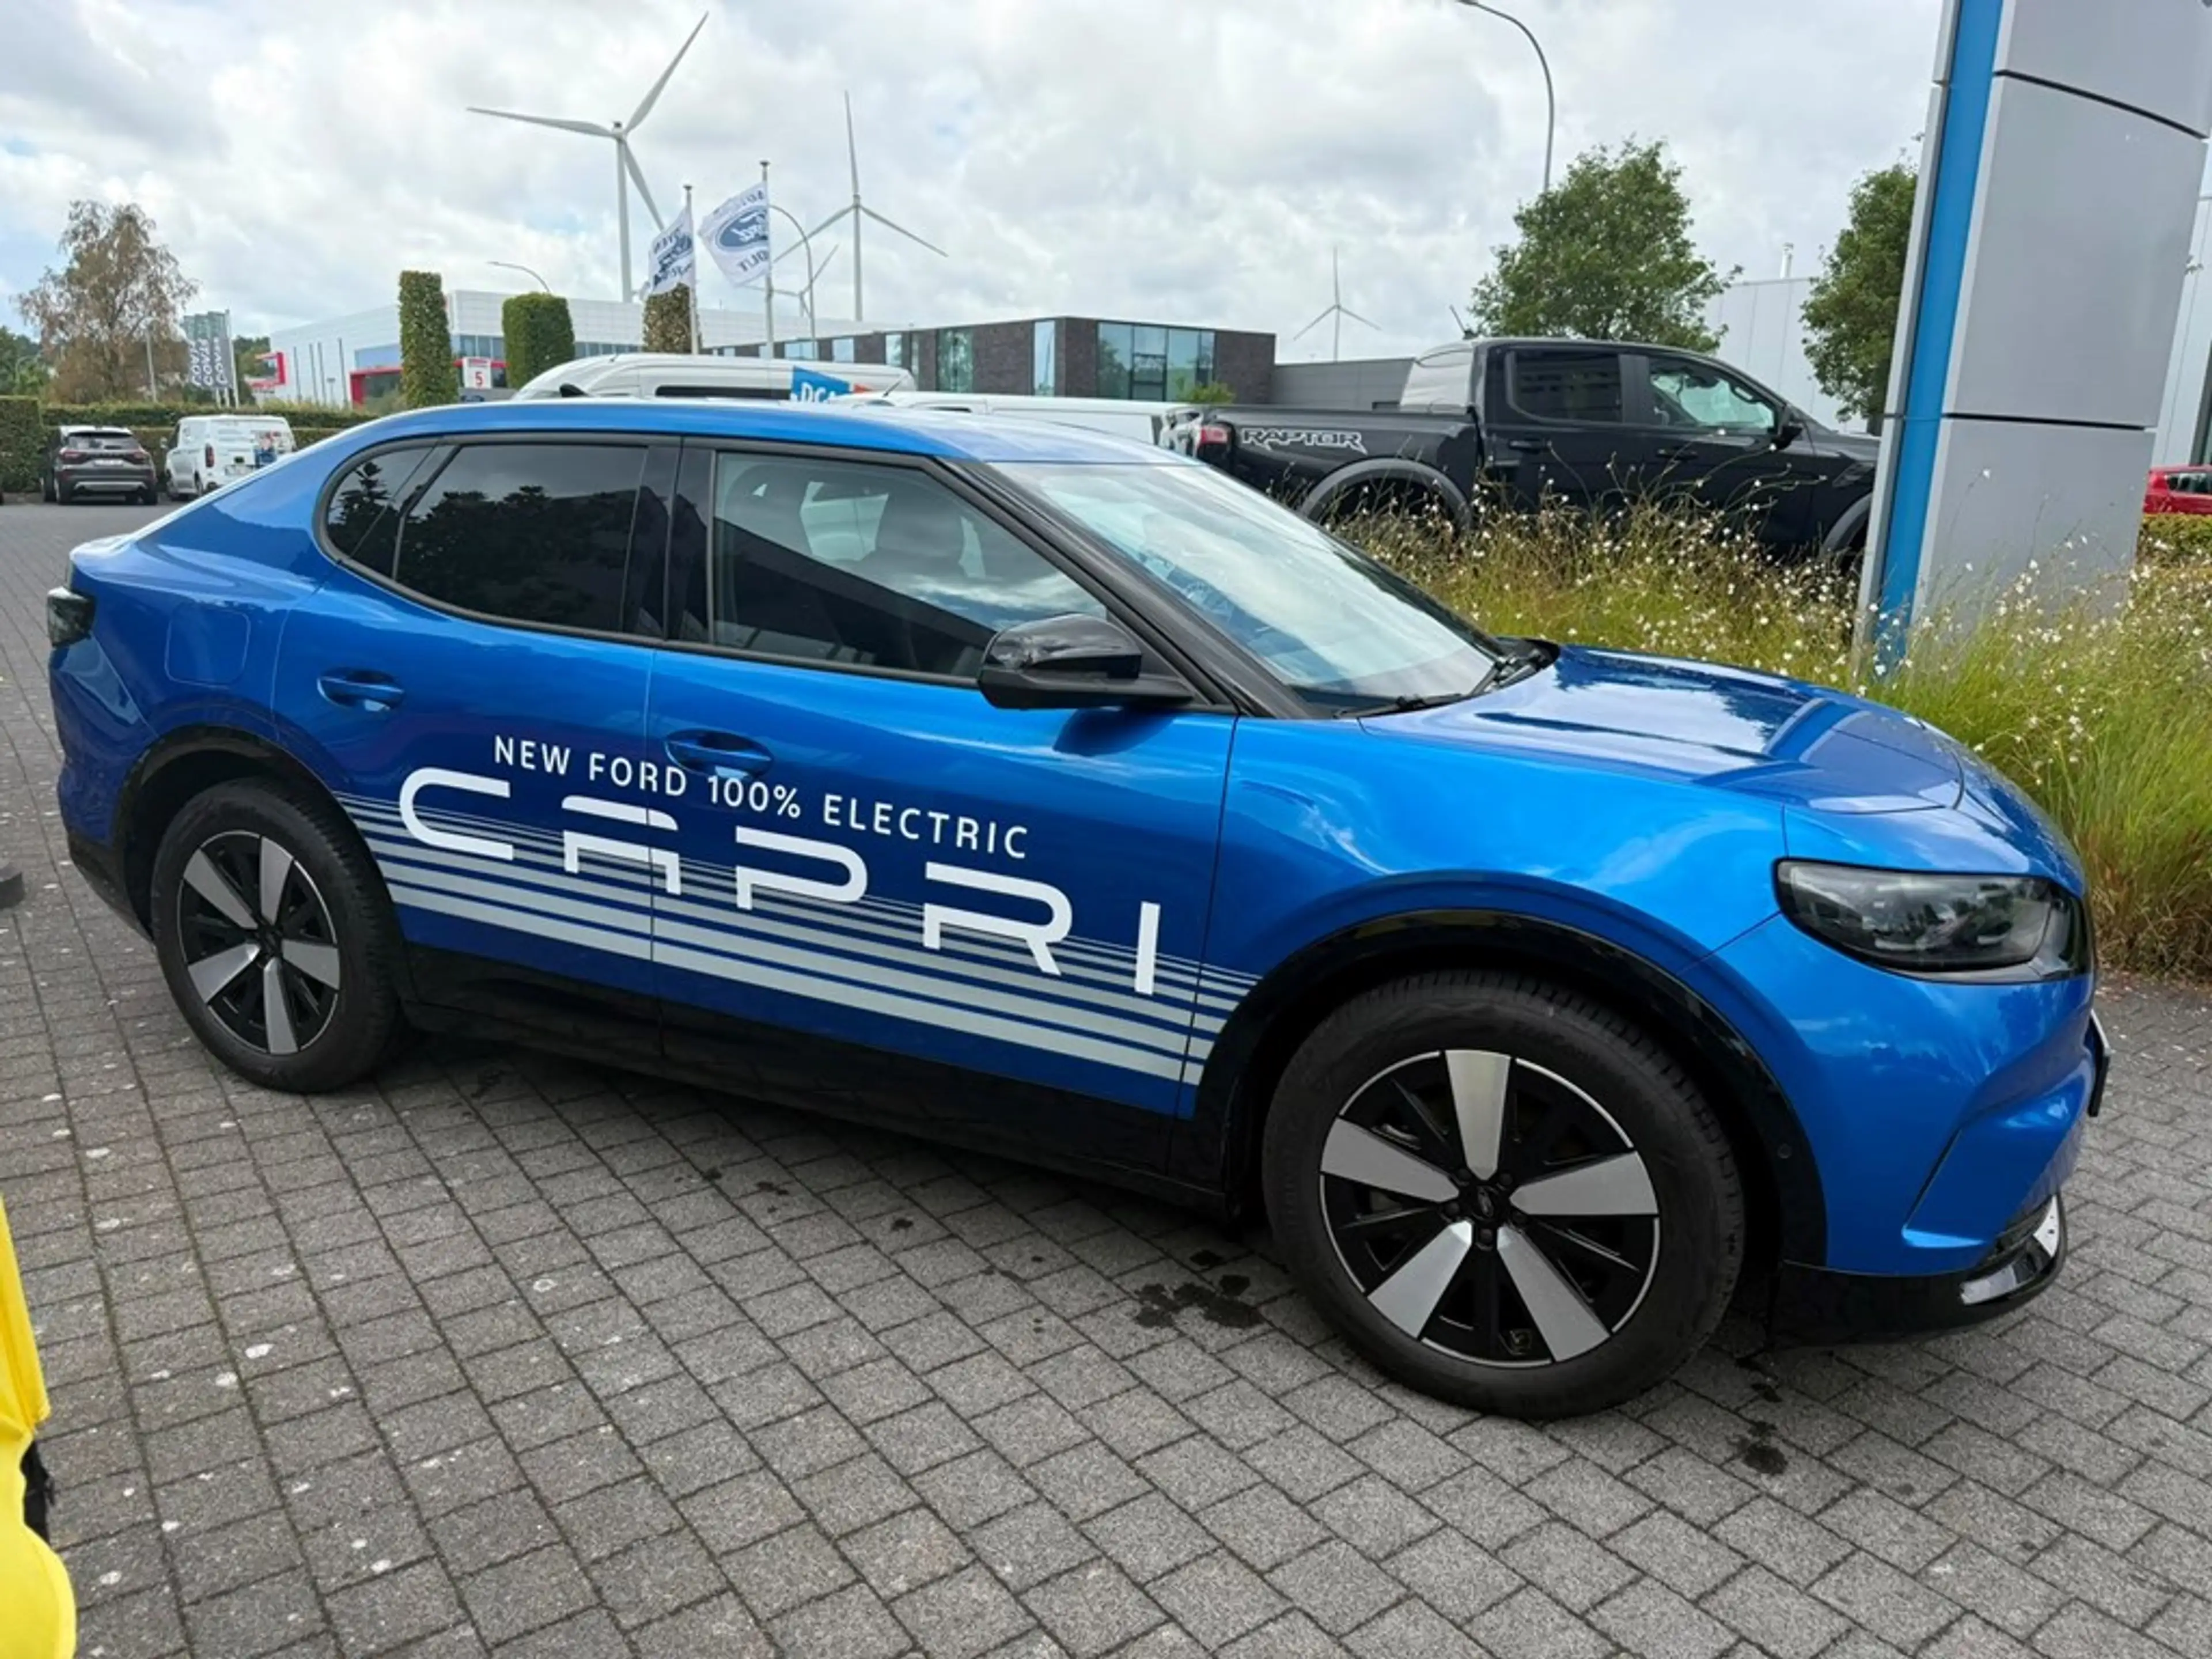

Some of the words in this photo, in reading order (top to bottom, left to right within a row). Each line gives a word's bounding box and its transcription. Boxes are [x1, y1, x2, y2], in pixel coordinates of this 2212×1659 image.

[475, 371, 483, 386] 5
[1242, 428, 1369, 455] RAPTOR
[494, 734, 571, 776] NEW
[589, 752, 687, 797] FORD
[707, 775, 801, 819] 100%
[823, 793, 1028, 858] ELECTRIC
[399, 766, 1161, 996] CAPRI
